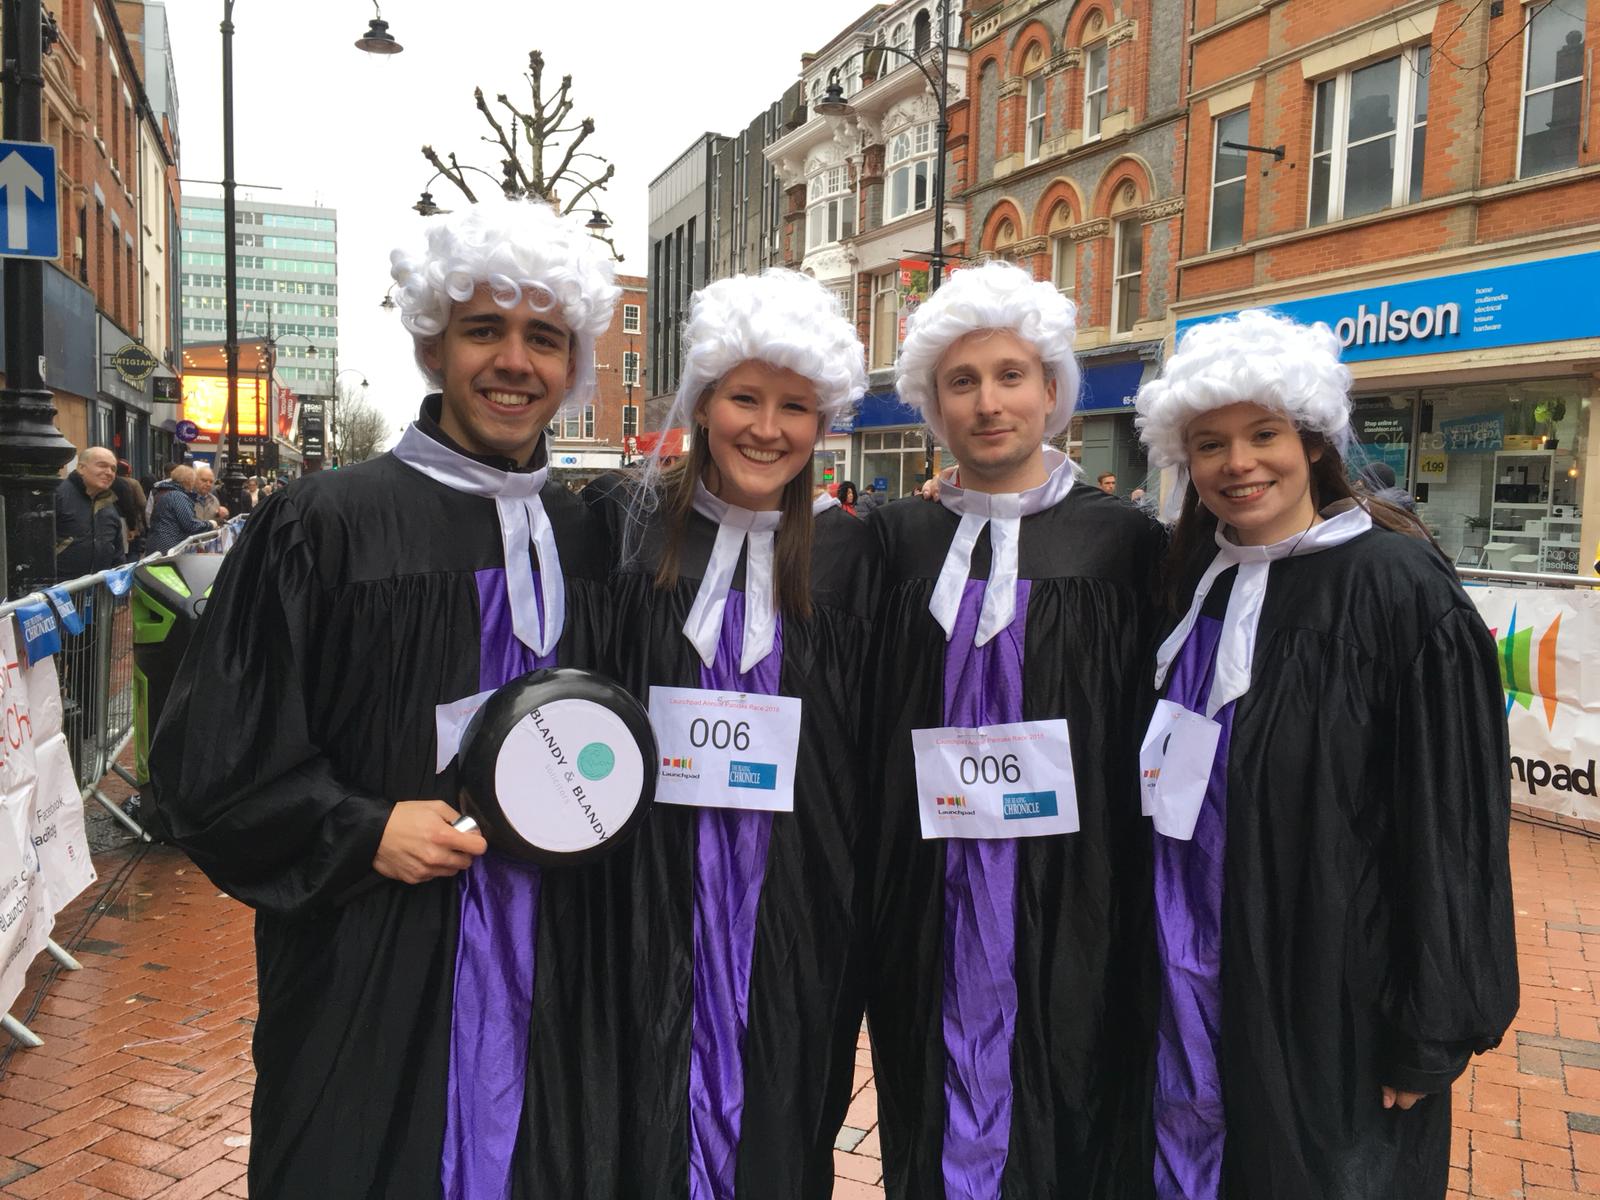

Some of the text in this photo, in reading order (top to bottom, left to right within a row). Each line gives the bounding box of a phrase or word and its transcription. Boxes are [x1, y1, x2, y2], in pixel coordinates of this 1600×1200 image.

[1475, 286, 1493, 295] home
[1475, 293, 1508, 304] multimedia
[1474, 304, 1502, 314] electrical
[1335, 301, 1459, 347] ohlson
[1473, 323, 1502, 333] hardware
[111, 358, 158, 367] ARTIGIANO
[690, 718, 750, 751] 006
[529, 709, 609, 841] BLANDY & BLANDY
[662, 770, 700, 780] Launchpad
[960, 754, 1021, 785] 006
[730, 771, 760, 785] CHRONICLE
[938, 809, 976, 817] Launchpad
[1004, 802, 1039, 815] CHRONICLE
